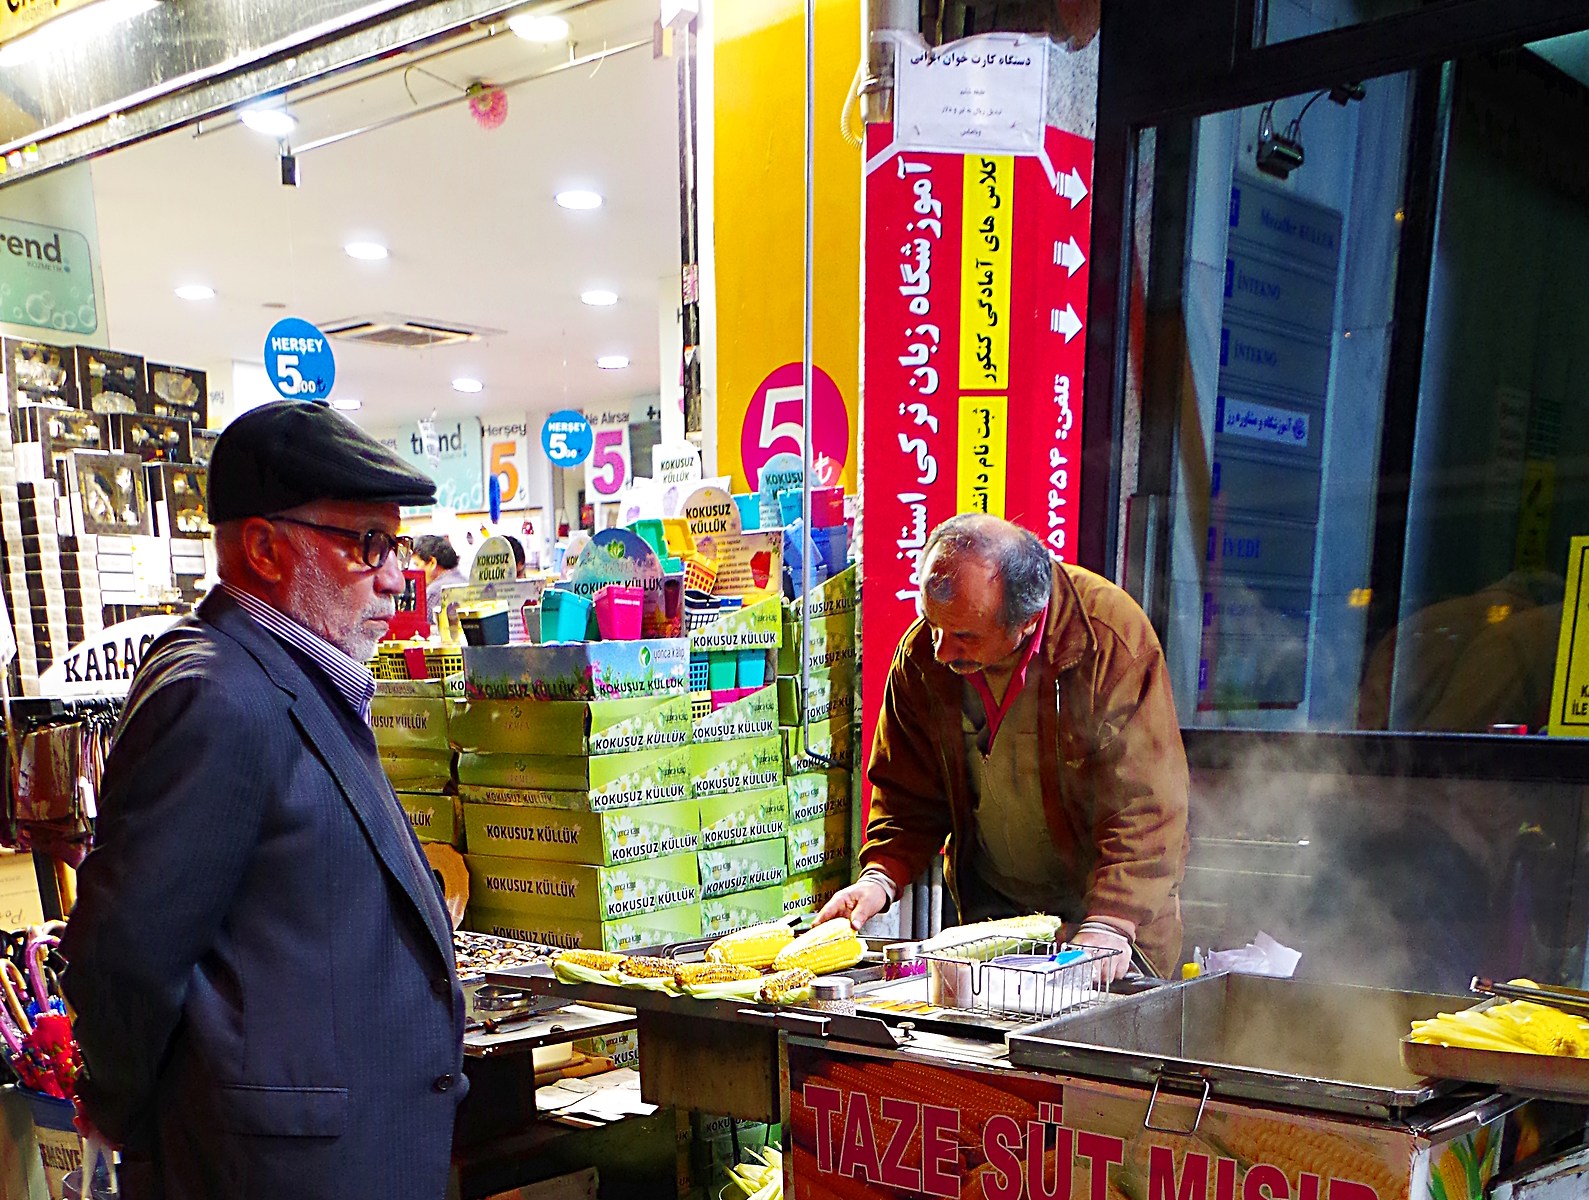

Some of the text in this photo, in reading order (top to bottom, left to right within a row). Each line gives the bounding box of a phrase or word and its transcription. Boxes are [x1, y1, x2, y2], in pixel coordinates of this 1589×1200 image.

[972, 54, 996, 68] کارت
[999, 54, 1031, 66] دستگاه
[898, 155, 942, 315] آموزشگاه
[975, 157, 1001, 384] کلاس های آمادگی کنکور
[271, 336, 323, 355] HERŞEY
[898, 323, 940, 394] زبان
[973, 408, 995, 438] ثبت
[898, 402, 938, 484] ترکی
[593, 430, 626, 495] 5
[660, 457, 694, 471] KOKUSUZ
[973, 444, 995, 467] نام
[491, 441, 519, 503] 5
[765, 472, 803, 486] KOKUSU
[685, 503, 731, 519] KOKUSUZ
[690, 520, 727, 535] KÜLLÜK
[476, 552, 509, 567] KOKUSUZ
[478, 568, 506, 582] KÜLLÜK
[693, 633, 776, 648] KOKUSUZ KÜLLÜK
[600, 678, 684, 694] KOKUSUZ KÜLLÜK
[693, 720, 773, 740] KOKUSUZ KÜLLÜK
[595, 731, 686, 750] KOKUSUZ KÜLLÜK
[696, 772, 778, 792] KOKUSUZ KÜLLÜK
[594, 784, 684, 806] KOKUSUZ KÜLLÜK
[487, 824, 578, 844] KOKUSUZ KÜLLÜK
[705, 822, 783, 843] KOKUSUZ KÜLLÜK
[612, 836, 698, 860] KOKUSUZ KÜLLÜK
[486, 876, 576, 898] KOKUSUZ KÜLLÜK
[706, 869, 782, 893] KOKUSUZ KÜLLÜK
[608, 888, 695, 915] KOKUSUZ KÜLLÜK
[803, 1083, 961, 1200] TAZE
